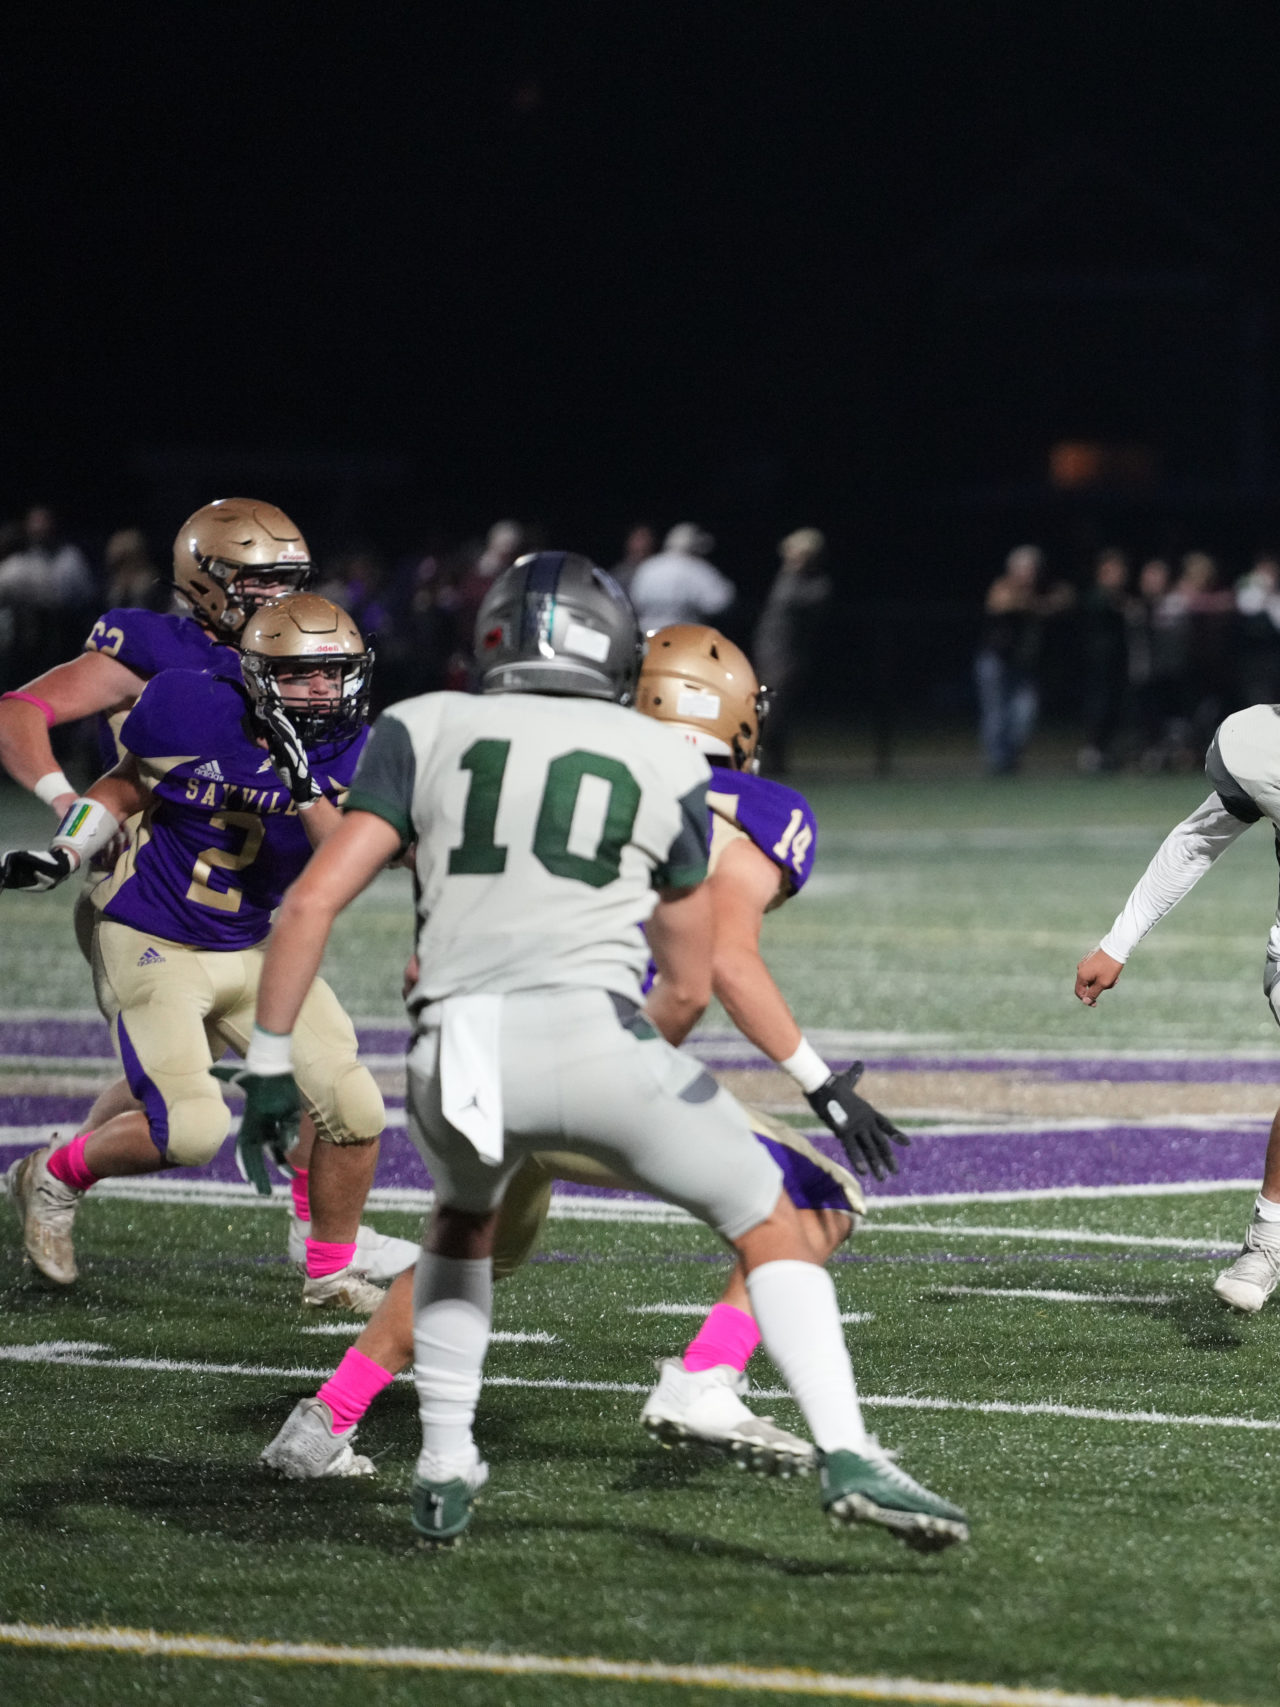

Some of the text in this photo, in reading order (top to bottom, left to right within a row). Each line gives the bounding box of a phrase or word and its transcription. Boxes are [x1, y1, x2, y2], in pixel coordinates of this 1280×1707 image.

[185, 777, 299, 816] SAYVILL
[194, 767, 224, 782] adidas
[447, 738, 641, 888] 10
[773, 808, 812, 875] 14
[186, 811, 265, 912] 2
